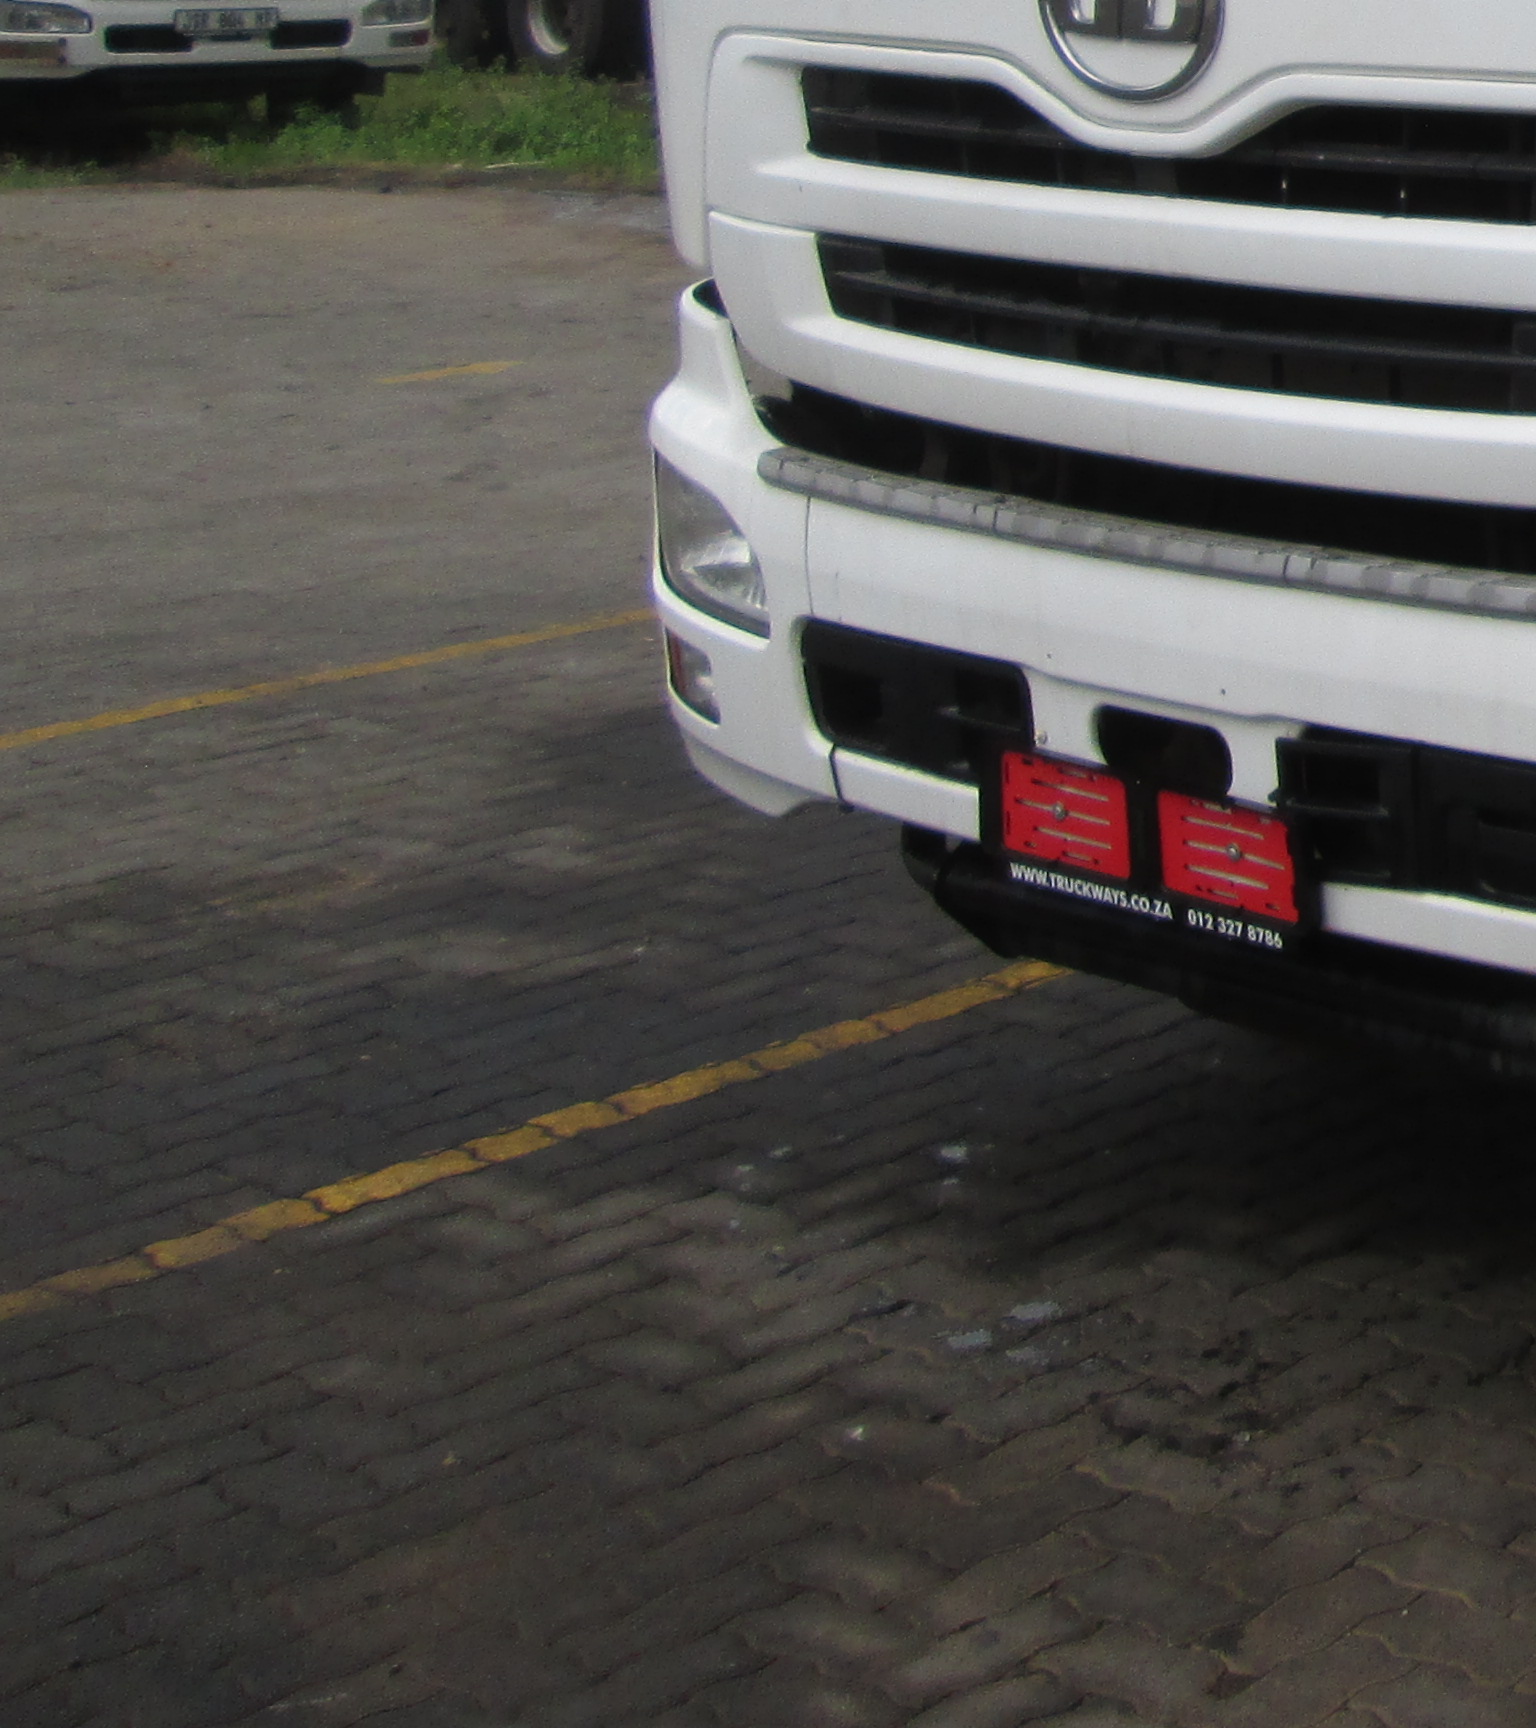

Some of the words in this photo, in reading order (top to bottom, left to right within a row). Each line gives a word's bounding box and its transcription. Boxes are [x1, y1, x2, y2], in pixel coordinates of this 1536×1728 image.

[1009, 861, 1174, 920] WWW.TRUCKWAYS.CO.ZA
[1187, 908, 1215, 931] 012
[1217, 916, 1244, 938] 327
